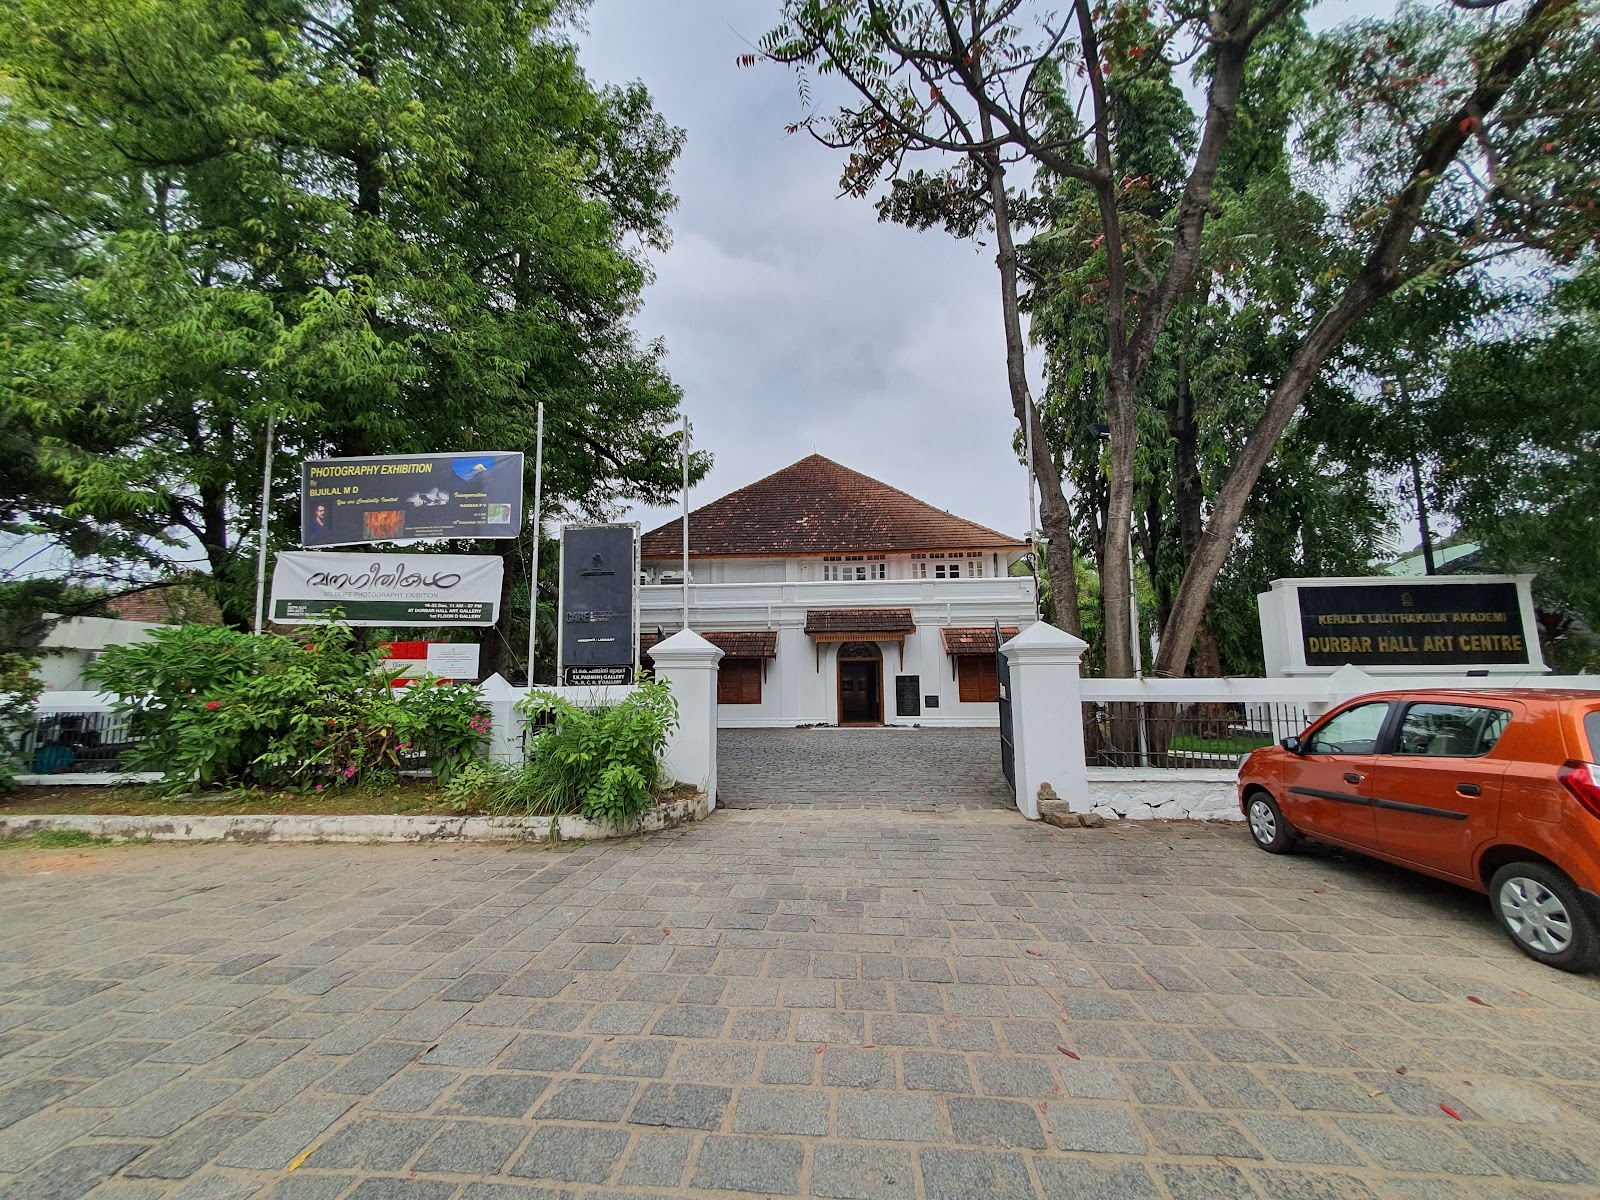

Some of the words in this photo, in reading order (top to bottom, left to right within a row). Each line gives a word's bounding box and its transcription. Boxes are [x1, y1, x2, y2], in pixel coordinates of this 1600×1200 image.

[310, 465, 380, 477] PHOTOGRAPHY
[380, 463, 432, 474] EXHIBITION
[310, 488, 342, 496] BIJULAL
[1318, 614, 1364, 625] KERALA
[1368, 613, 1448, 624] LALITHAKALA
[1452, 612, 1506, 623] AKADEMI
[1308, 636, 1372, 653] DURBAR
[1378, 635, 1418, 653] HALL
[1423, 635, 1454, 652] ART
[1458, 634, 1522, 652] CENTRE
